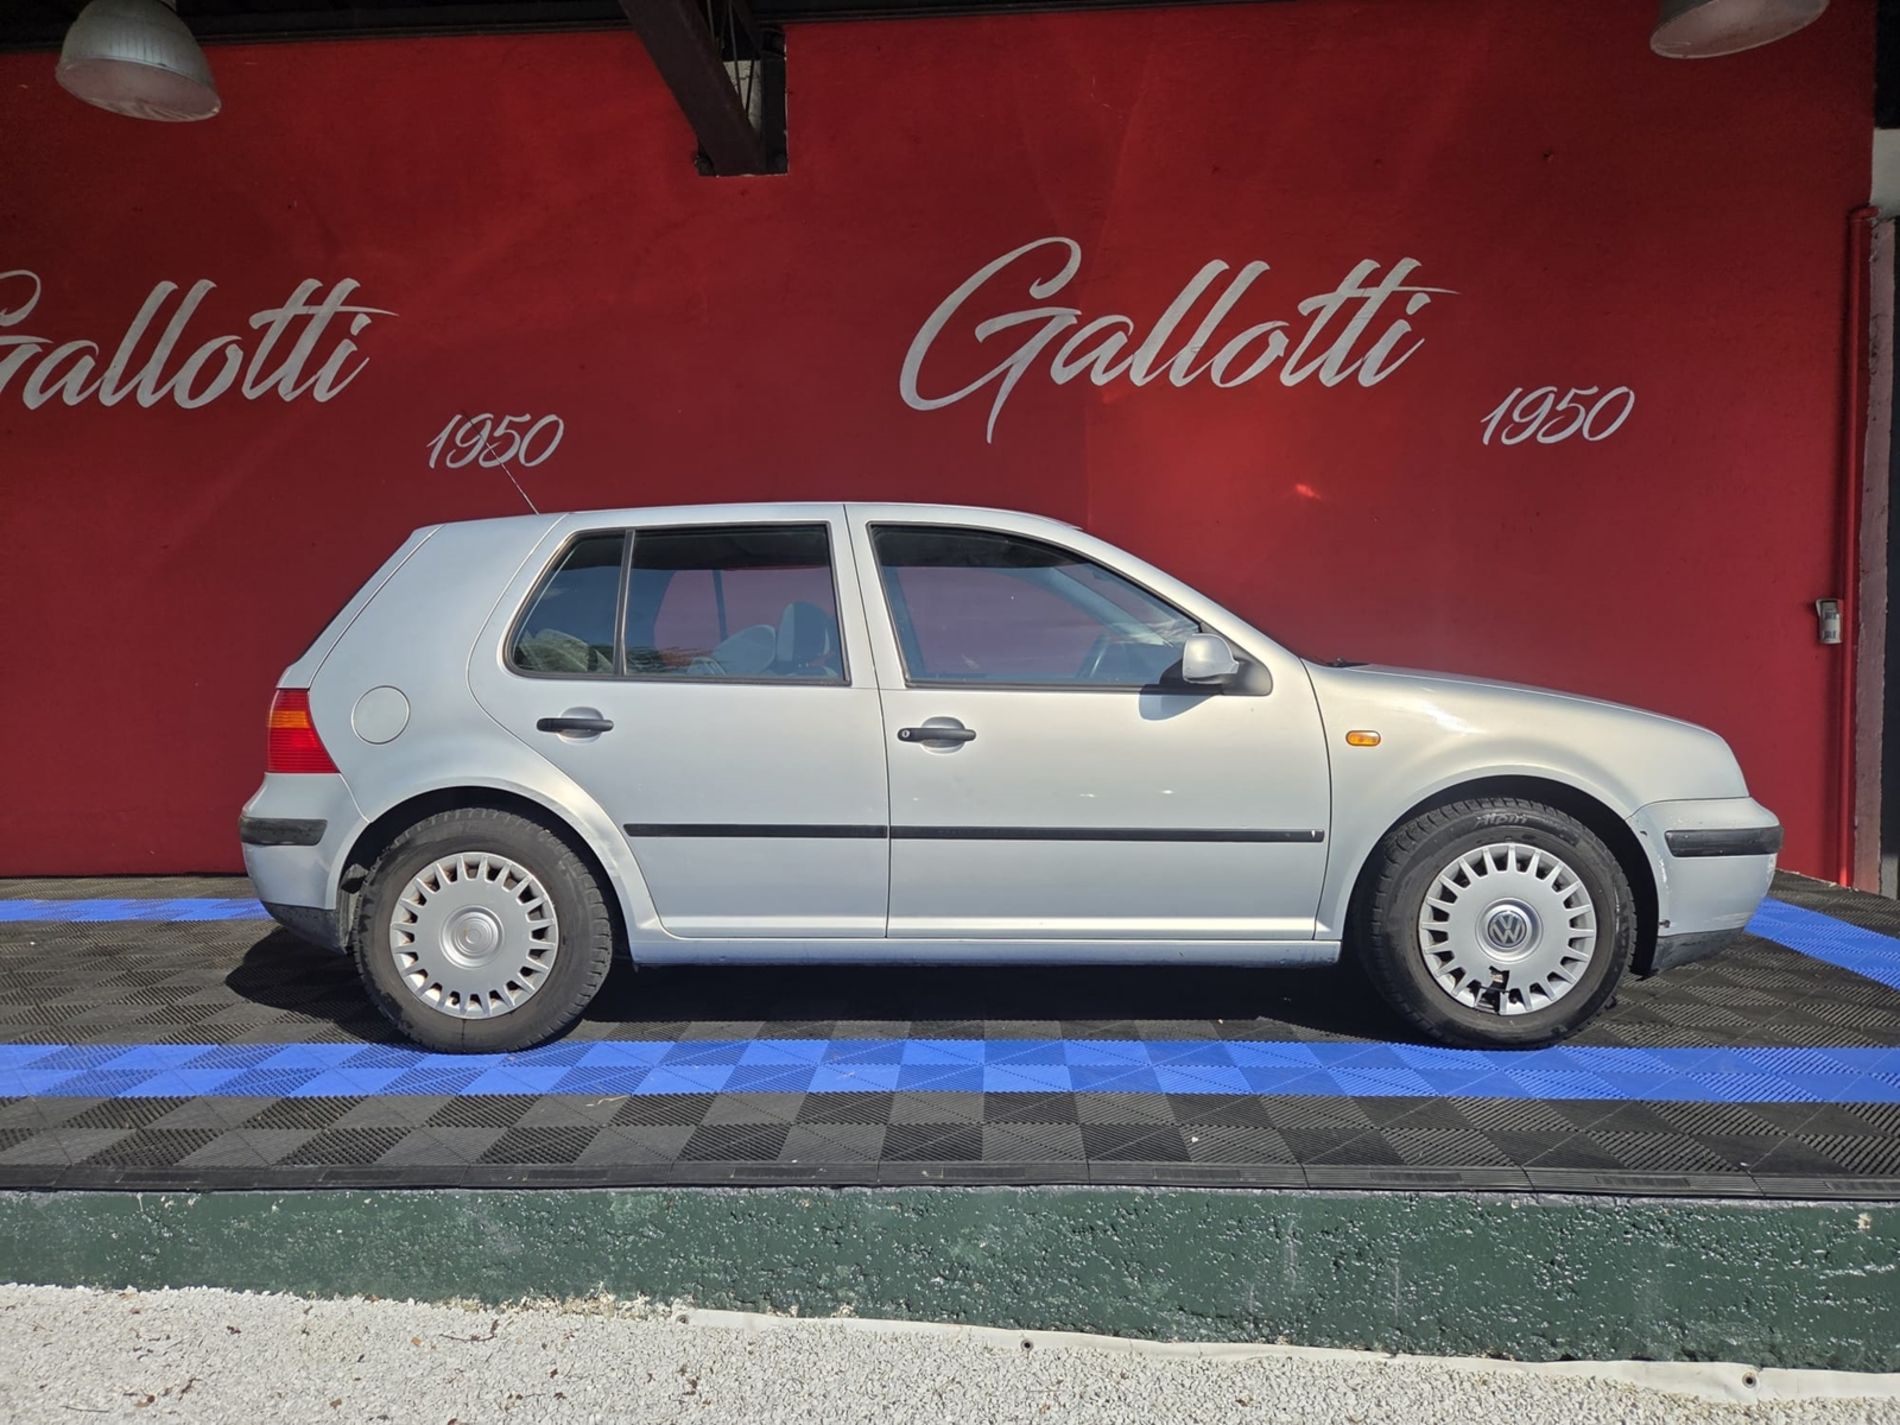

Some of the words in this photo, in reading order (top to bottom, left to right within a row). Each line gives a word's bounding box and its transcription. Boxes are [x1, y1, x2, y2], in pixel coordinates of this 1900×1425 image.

[900, 237, 1458, 443] Gallotti
[427, 413, 565, 469] 1950
[1481, 386, 1636, 446] 1950
[1489, 912, 1526, 946] VW
